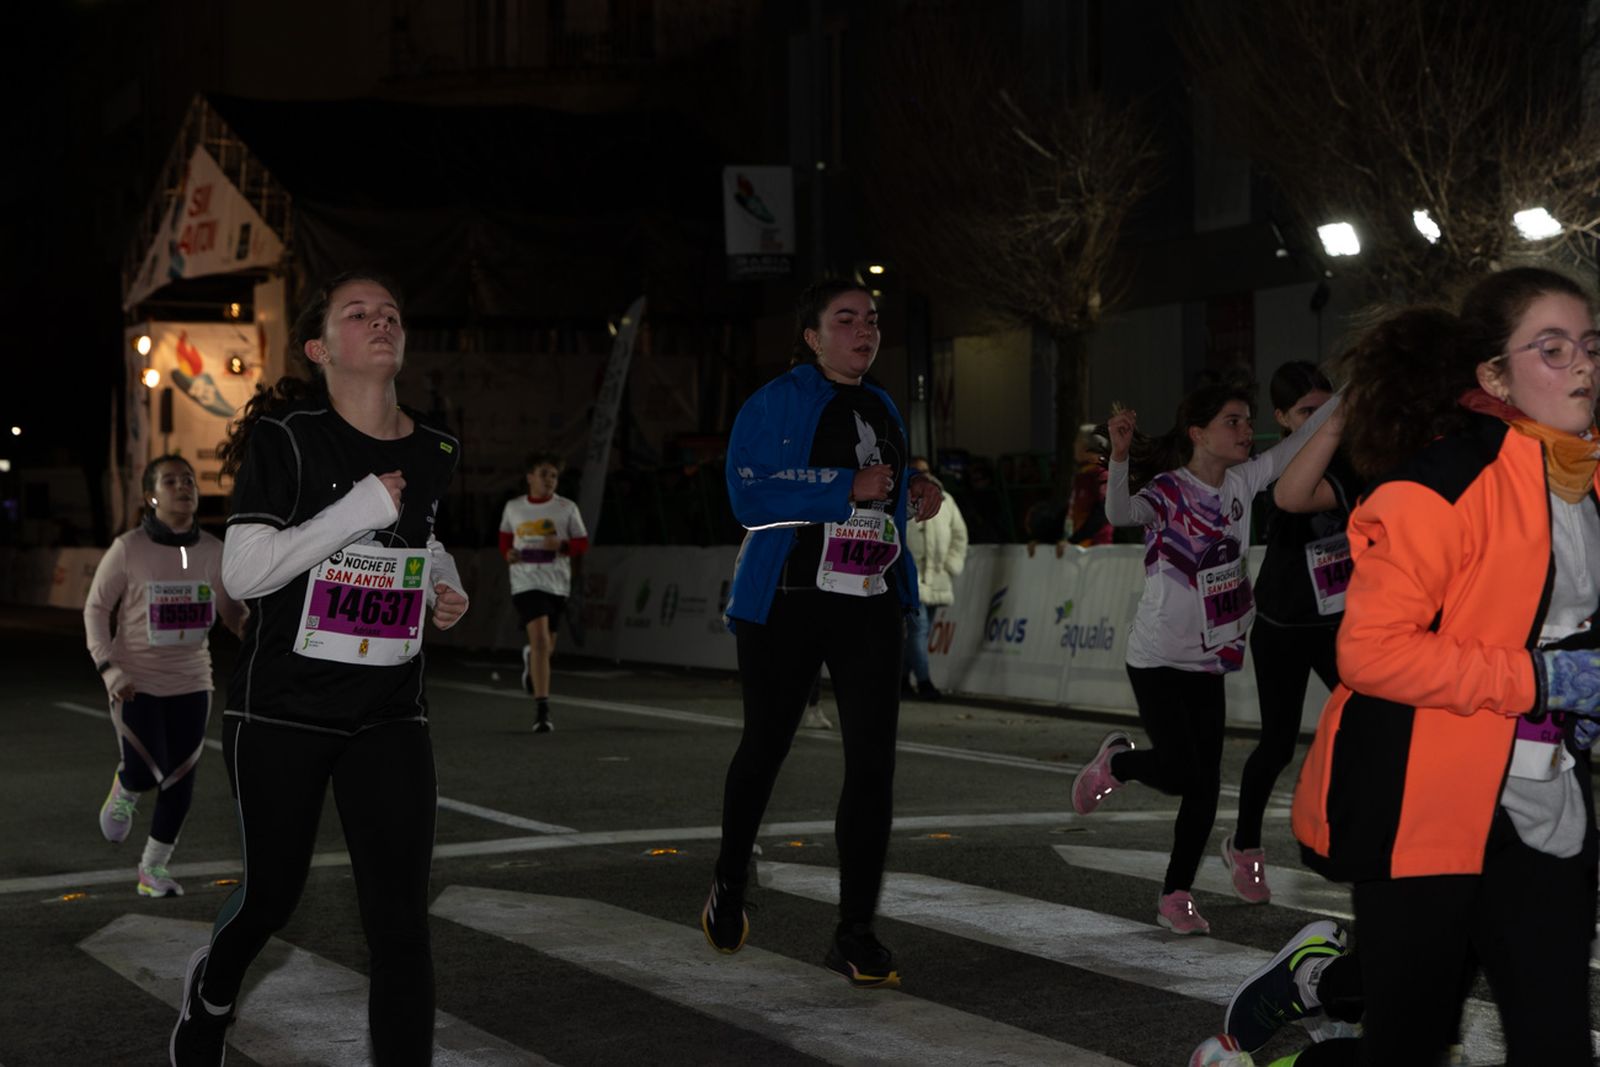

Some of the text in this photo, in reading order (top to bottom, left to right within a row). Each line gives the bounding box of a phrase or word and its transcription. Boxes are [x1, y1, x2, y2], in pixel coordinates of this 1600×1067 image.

[835, 528, 880, 540] SAN ANTN
[344, 556, 384, 573] NOCHE
[384, 561, 397, 573] DE
[325, 568, 353, 583] SAN
[353, 571, 395, 588] ANTÓN
[1207, 583, 1223, 594] SAN
[159, 603, 207, 625] 15557
[326, 585, 415, 626] 14637
[1060, 617, 1115, 657] aqualia
